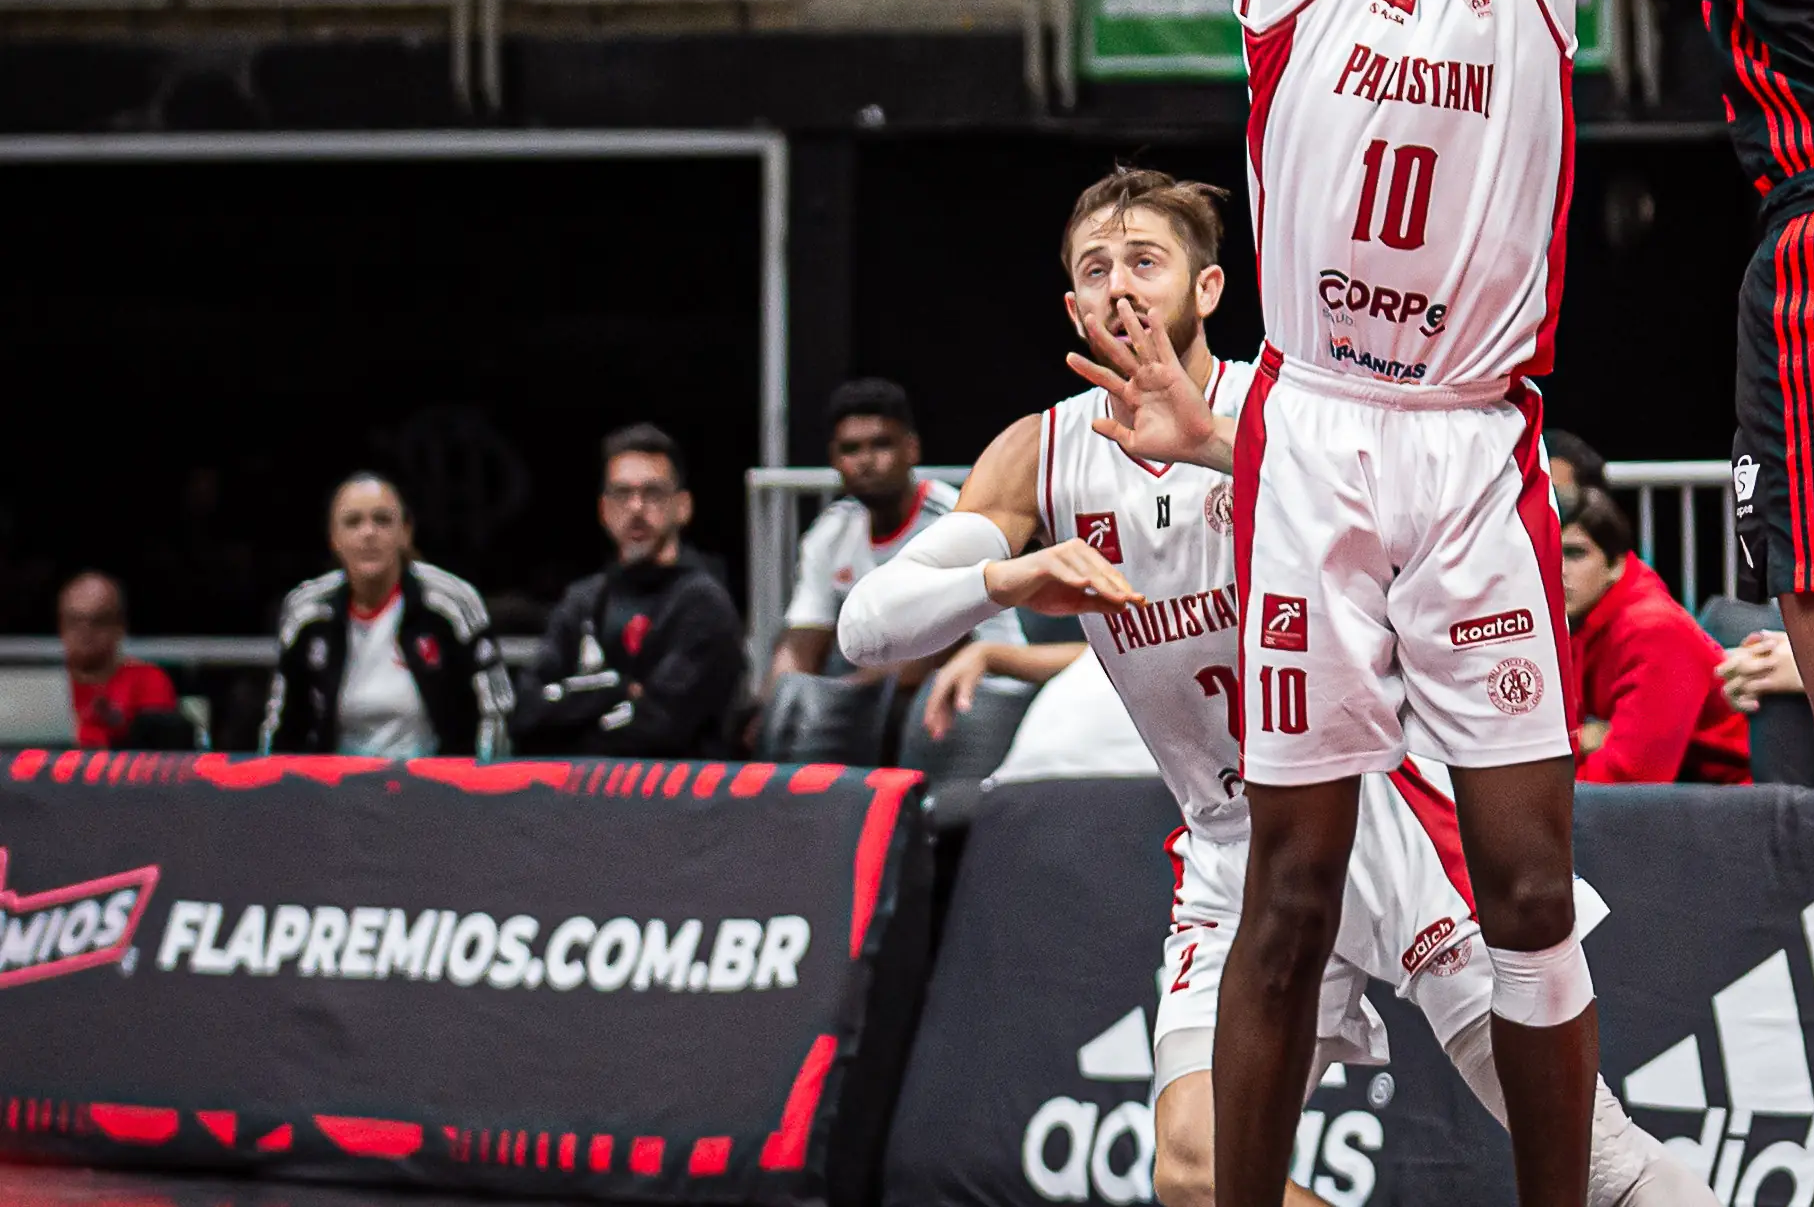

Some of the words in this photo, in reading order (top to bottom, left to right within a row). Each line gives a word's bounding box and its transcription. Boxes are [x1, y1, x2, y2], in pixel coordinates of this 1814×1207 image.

[1351, 139, 1438, 251] 10
[1457, 613, 1529, 643] koatch
[1260, 664, 1310, 735] 10
[0, 889, 138, 970] MIOS
[157, 899, 811, 993] FLAPREMIOS.COM.BR
[1170, 942, 1199, 994] 2
